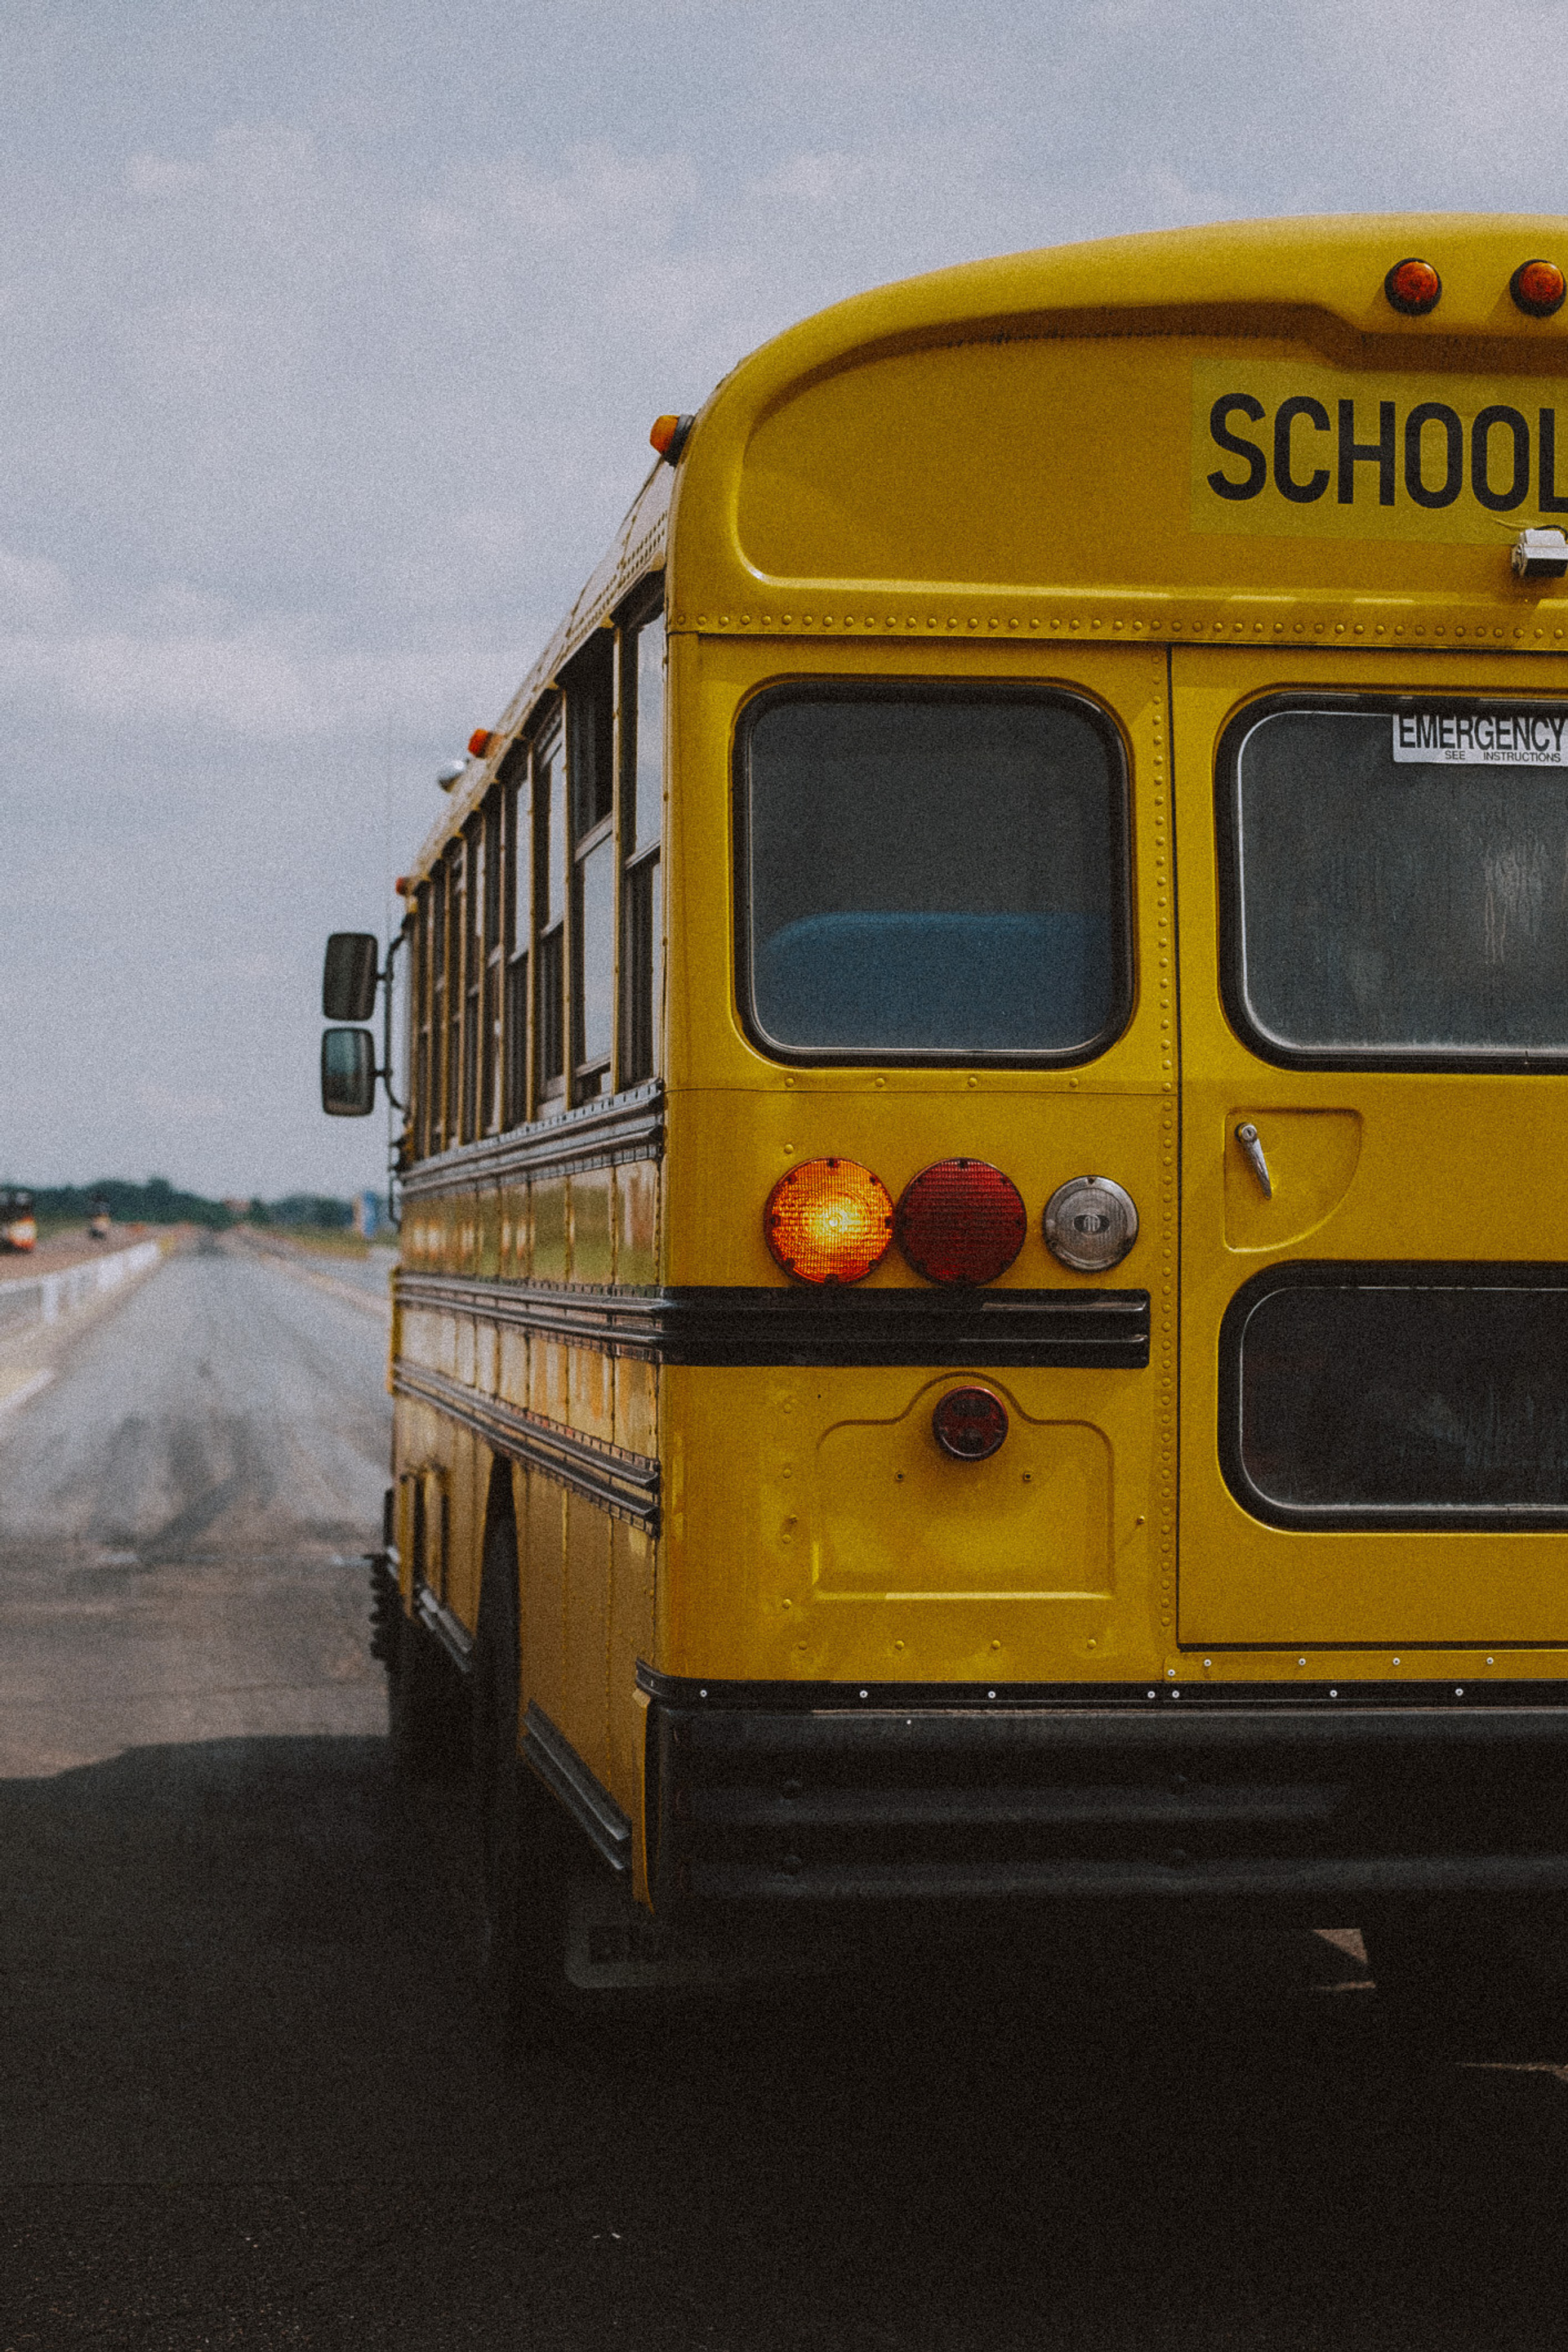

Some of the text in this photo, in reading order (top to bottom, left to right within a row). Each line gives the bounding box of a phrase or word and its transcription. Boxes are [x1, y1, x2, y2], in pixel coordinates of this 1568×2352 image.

[1207, 393, 1568, 513] SCHOOL
[1399, 715, 1566, 751] EMERGENCY
[1445, 751, 1561, 763] SEE INSTRUCTIONS
